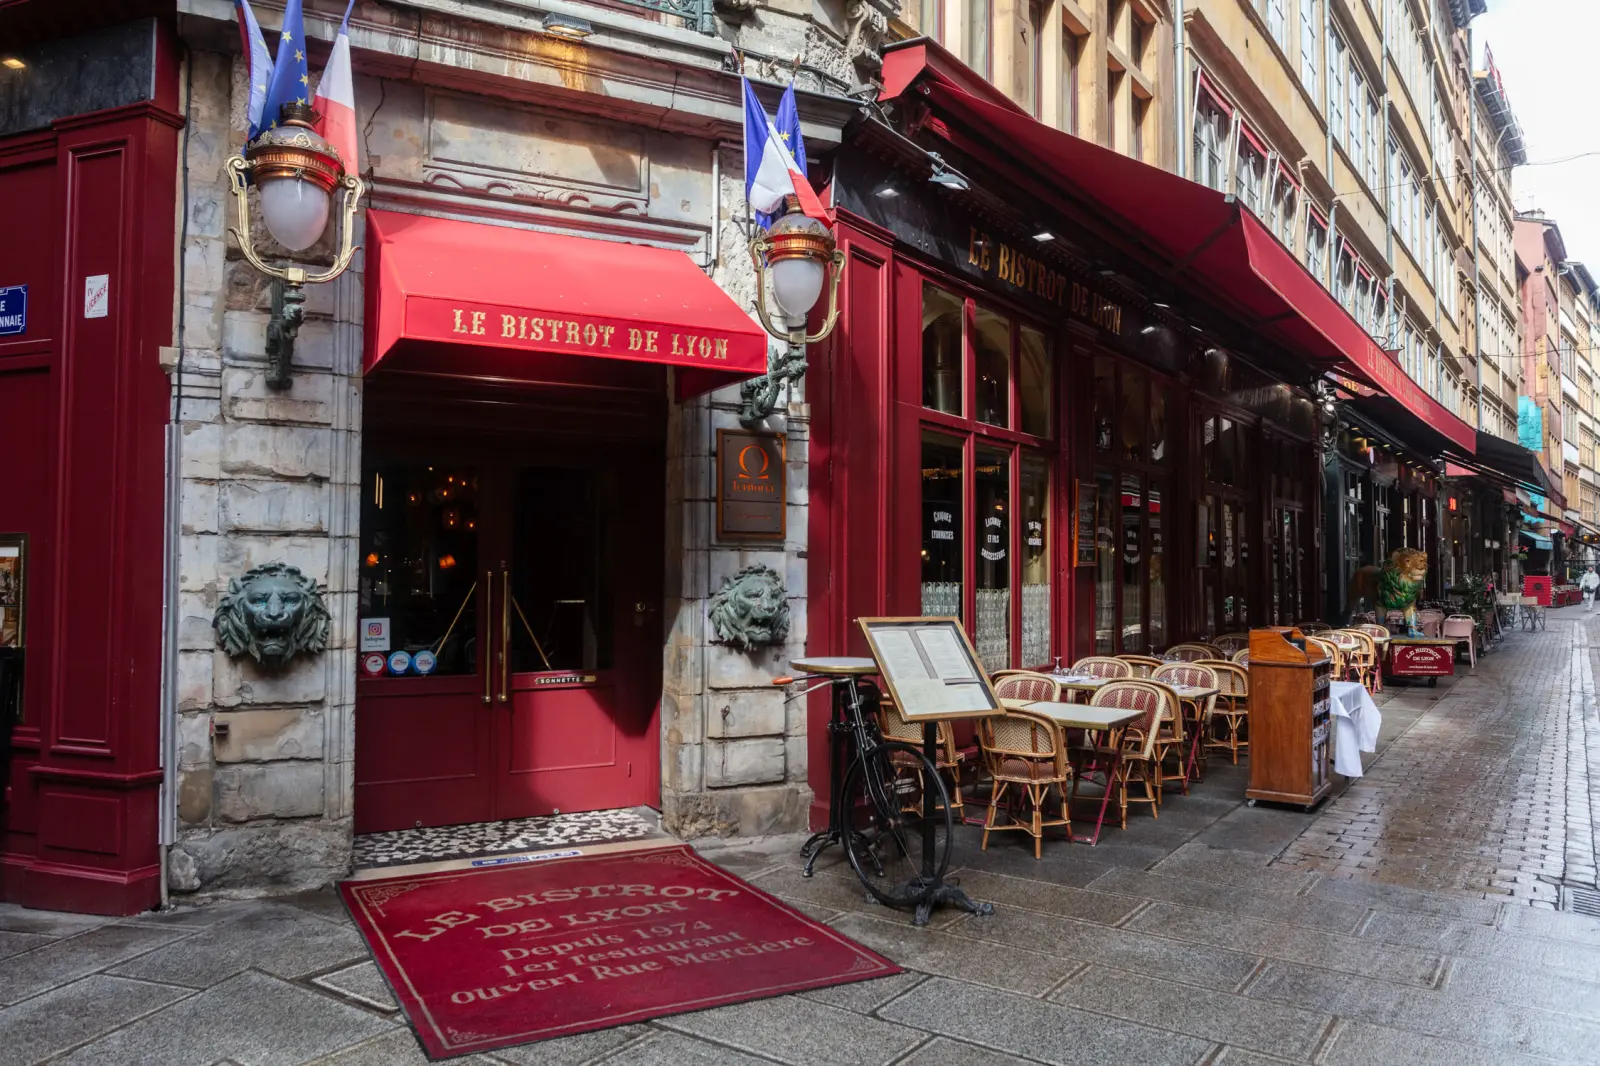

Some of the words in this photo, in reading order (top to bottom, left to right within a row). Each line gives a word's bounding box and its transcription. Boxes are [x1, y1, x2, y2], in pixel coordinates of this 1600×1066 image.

[86, 280, 107, 313] LICENCE
[968, 226, 992, 272] LE
[998, 243, 1067, 307] BISTROT
[1071, 281, 1089, 317] DE
[1092, 292, 1122, 336] LYON
[452, 308, 486, 336] LE
[500, 313, 615, 348] BISTROT
[628, 327, 659, 353] DE
[670, 332, 729, 361] LYON
[393, 911, 480, 942] LE
[476, 883, 741, 913] BISTROT
[476, 918, 554, 939] DE
[559, 899, 688, 926] LYON
[499, 932, 625, 961] Depuis
[632, 920, 714, 940] 1974
[500, 959, 561, 978] 1er
[569, 930, 748, 967] restaurant
[450, 973, 585, 1005] ouvert
[590, 957, 664, 980] Rue
[666, 935, 815, 967] Mercière
